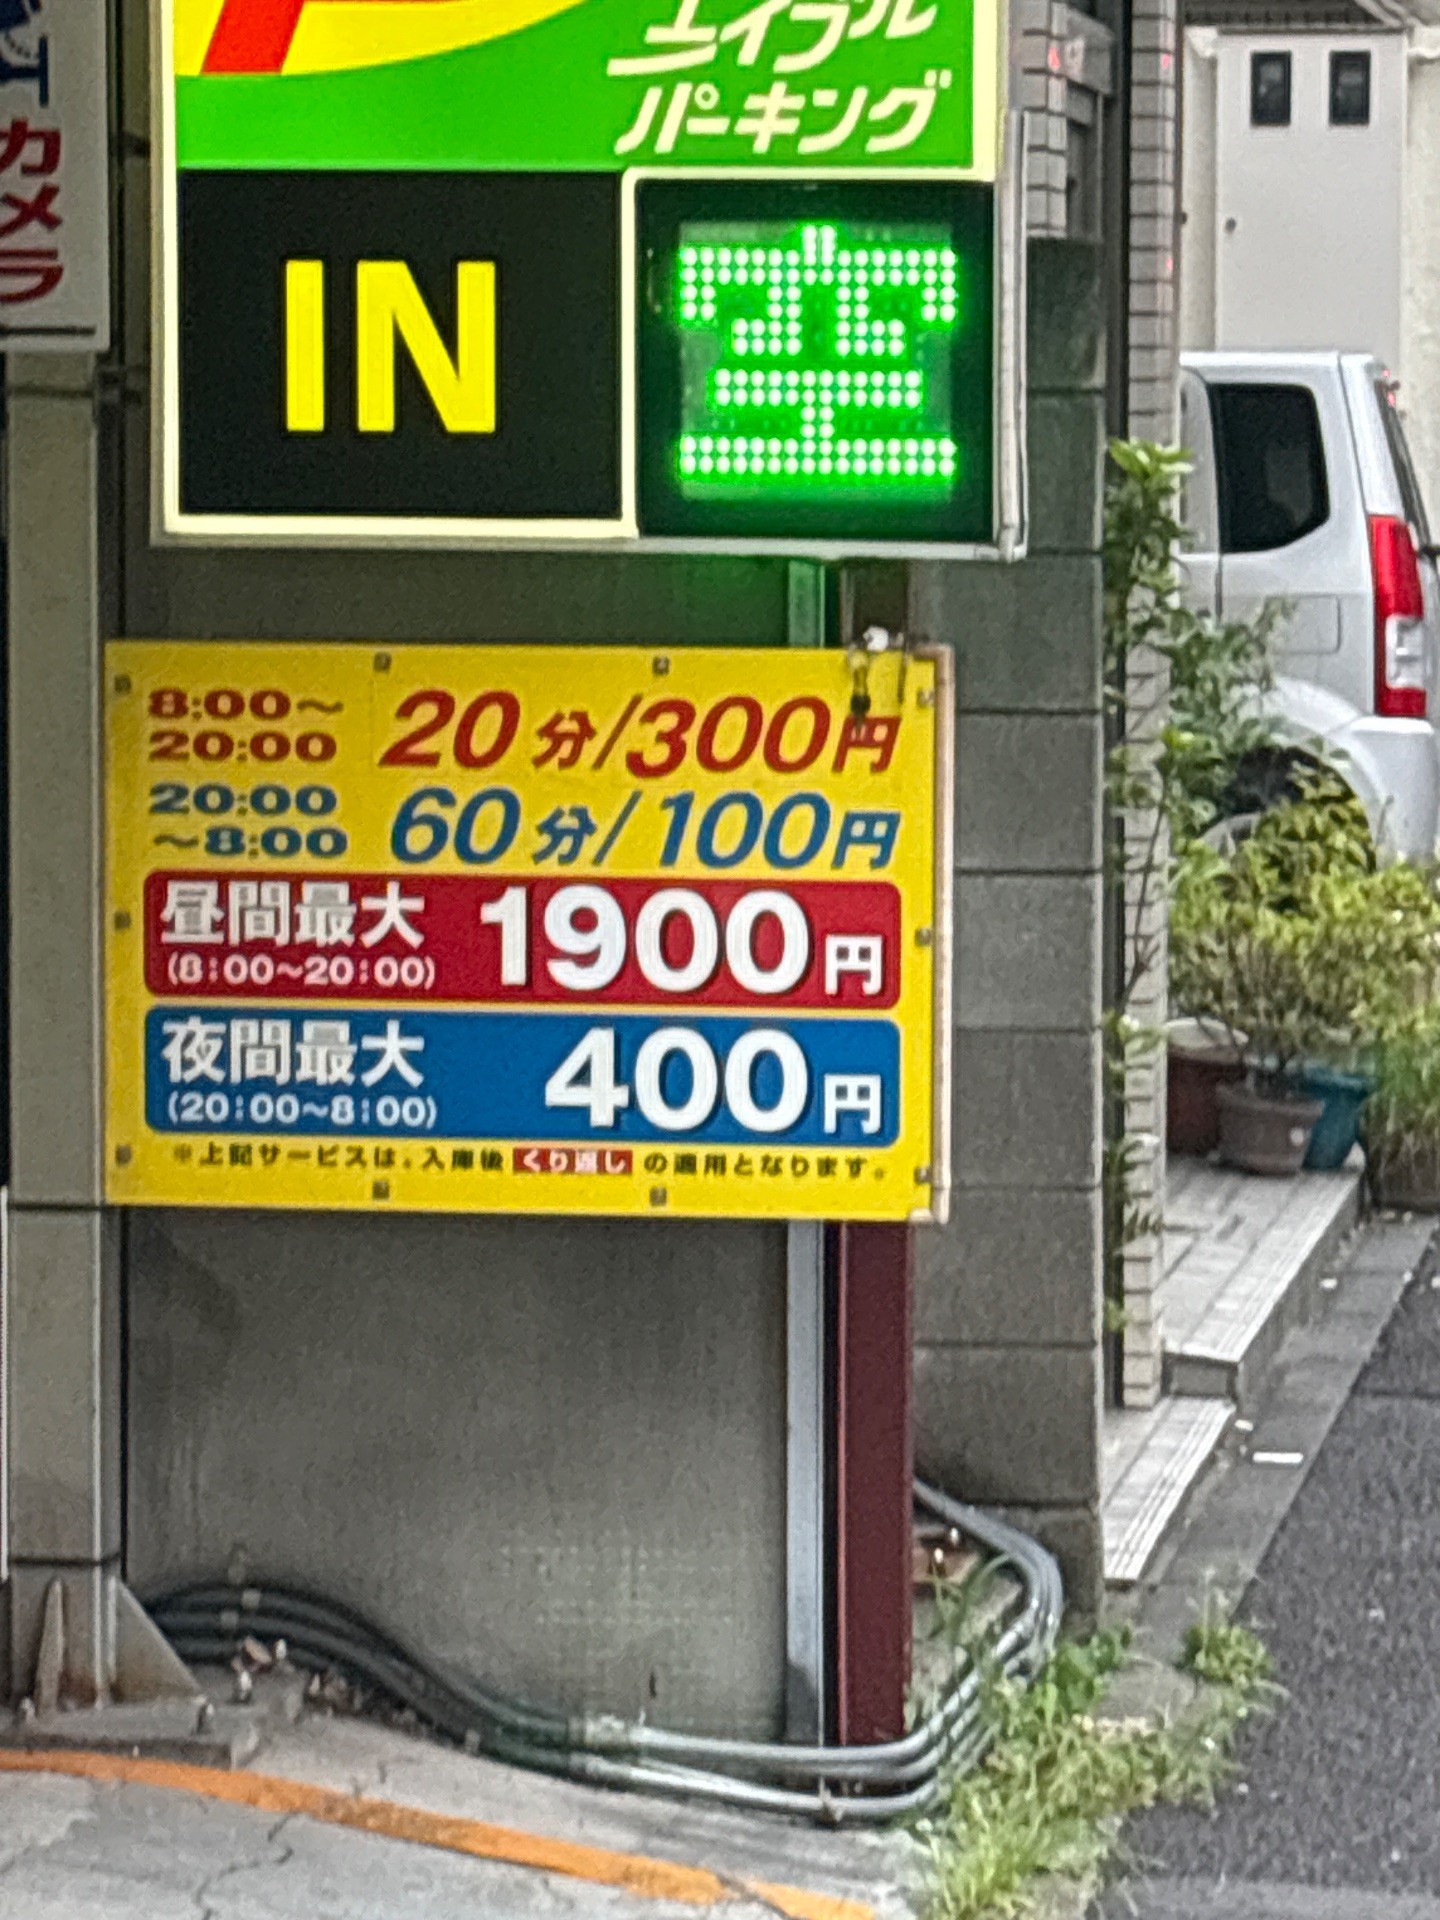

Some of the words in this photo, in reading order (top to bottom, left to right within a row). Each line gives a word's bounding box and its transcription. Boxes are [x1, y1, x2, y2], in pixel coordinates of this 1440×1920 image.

[614, 69, 952, 154] パーキング
[286, 260, 496, 433] IN
[680, 225, 956, 475] 空
[148, 730, 337, 763] 20:00
[149, 783, 337, 816] 20:00
[161, 880, 426, 949] 昼間最大
[480, 883, 884, 996] 1900円
[161, 1015, 426, 1088] 夜間最大
[545, 1026, 882, 1135] 400円
